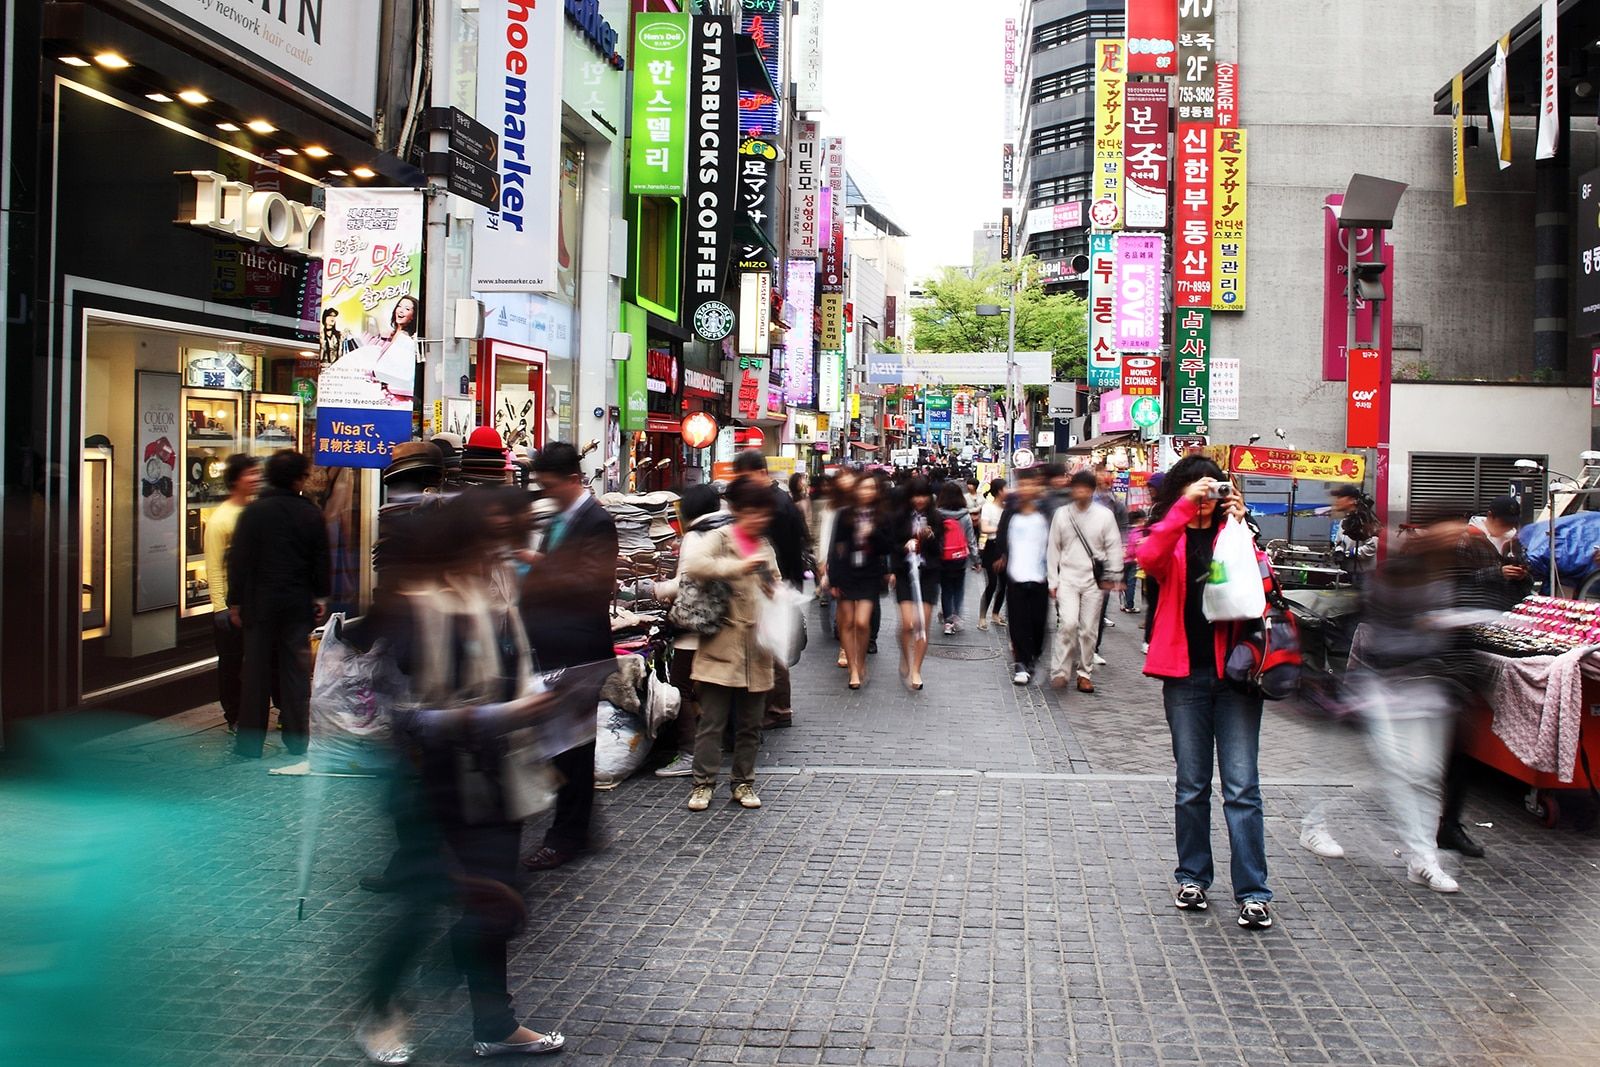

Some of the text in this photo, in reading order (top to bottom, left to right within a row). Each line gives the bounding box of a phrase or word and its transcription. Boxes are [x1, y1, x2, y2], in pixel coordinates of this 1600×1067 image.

[215, 0, 261, 36] network
[262, 23, 284, 47] hair
[285, 41, 313, 66] castle
[1187, 56, 1208, 81] 2F
[646, 60, 675, 173] 한스델리
[1180, 106, 1214, 118] 명동점
[1218, 113, 1232, 126] 1F
[697, 22, 722, 294] STARBUCKS COFFEE
[1582, 183, 1592, 199] 8F
[1182, 129, 1209, 275] 신한부동산
[802, 194, 815, 248] 성형외과
[1215, 220, 1243, 230] 컨디션
[238, 251, 299, 279] THE GIFT
[739, 261, 767, 270] MIZO
[1221, 244, 1238, 290] 발관리
[478, 277, 544, 285] www.shoemarker.co.kr
[1177, 281, 1211, 292] 771-8959
[1121, 265, 1146, 338] LOVE
[1224, 294, 1235, 302] 4F
[1130, 369, 1152, 377] MONEY
[1098, 379, 1120, 387] 8959
[1125, 377, 1158, 386] EXCHANGE
[1352, 389, 1377, 401] CGV
[1355, 401, 1372, 409] 주차장
[144, 411, 175, 424] COLOR
